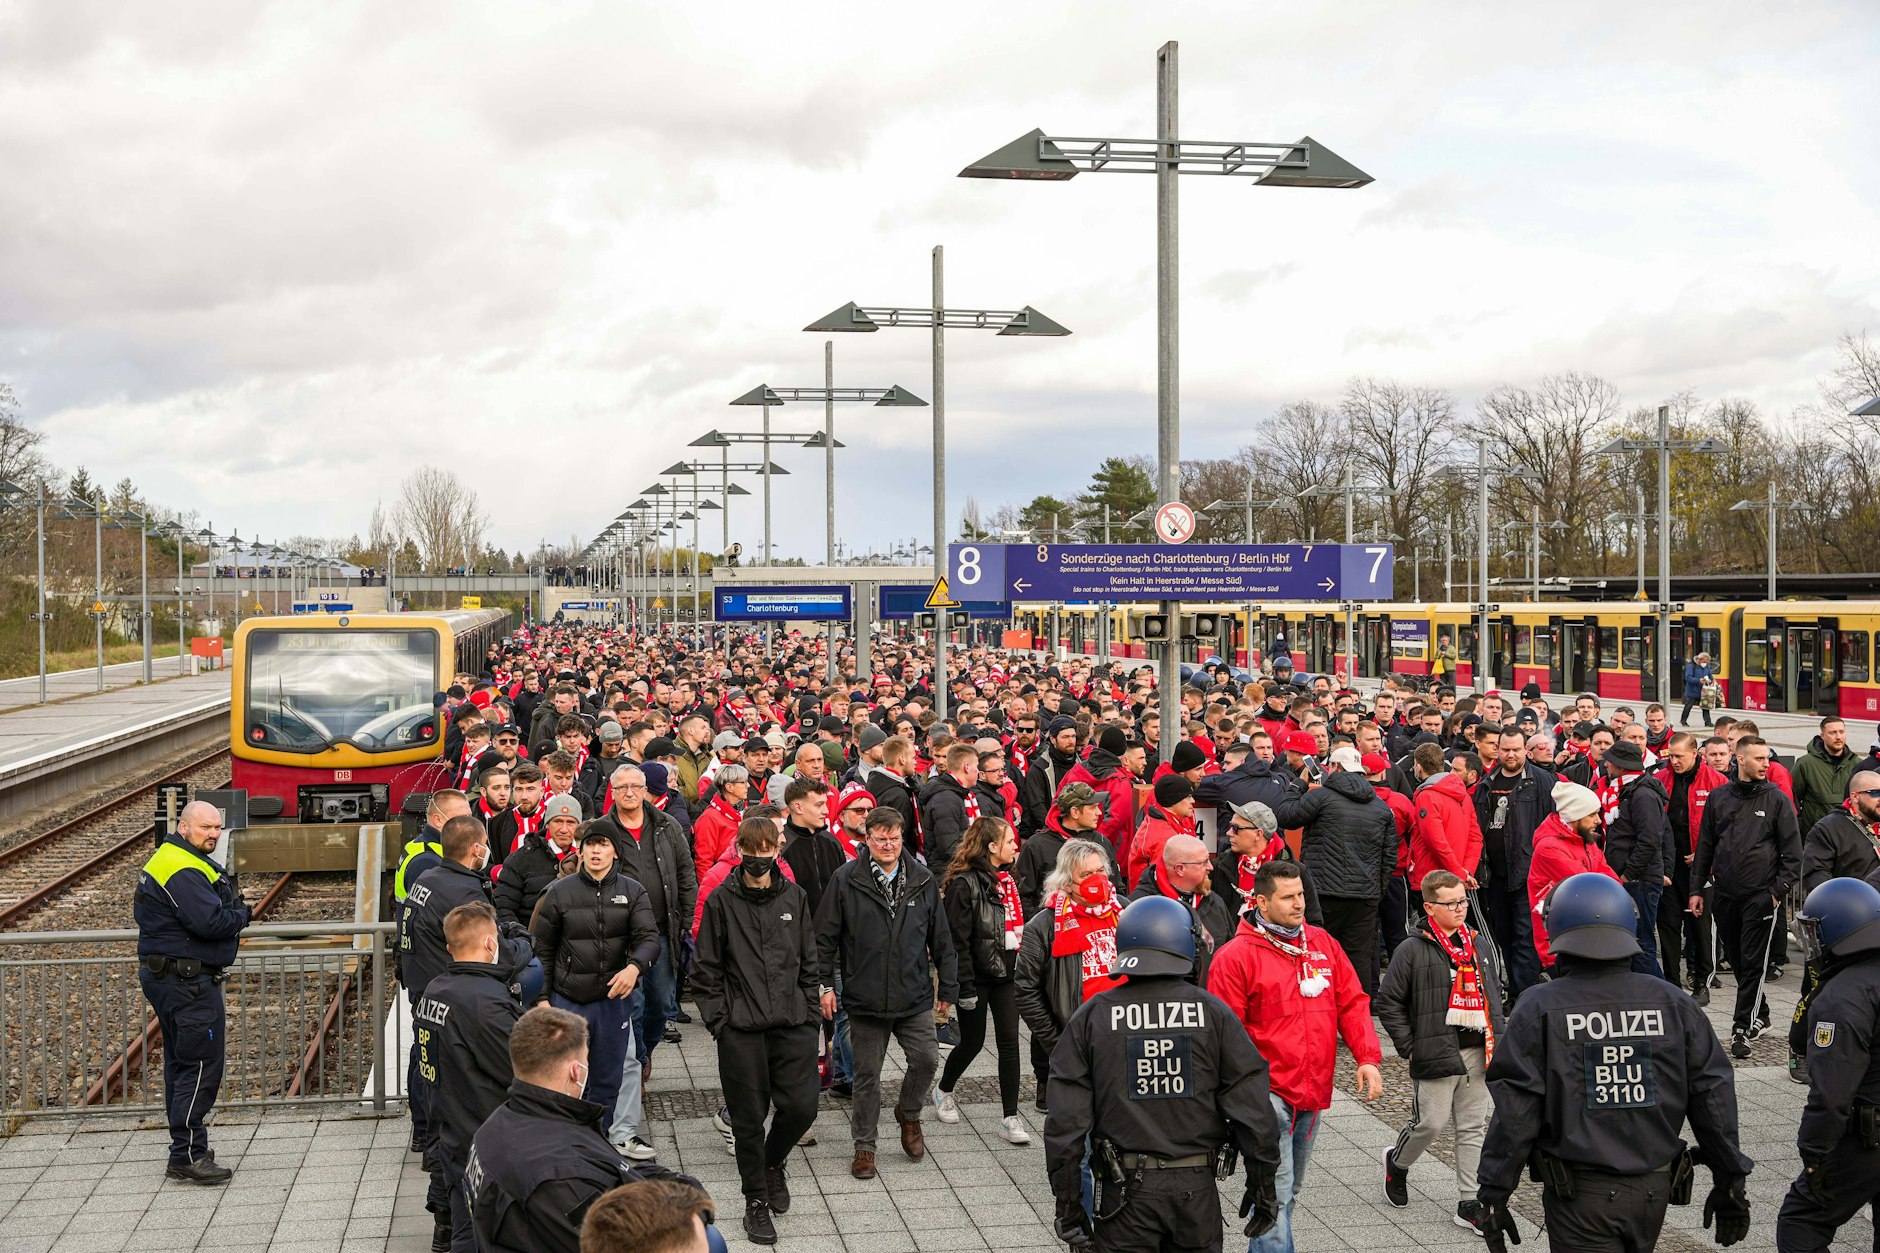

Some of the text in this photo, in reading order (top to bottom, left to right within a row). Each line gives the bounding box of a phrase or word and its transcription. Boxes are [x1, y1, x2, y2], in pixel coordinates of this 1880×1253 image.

[1037, 545, 1048, 562] 8
[1061, 553, 1290, 566] Sonderzüge nach Charlottenburg / Berlin Hbf
[1302, 545, 1313, 562] 7
[957, 546, 982, 585] 8
[1365, 547, 1387, 583] 7
[1110, 576, 1128, 585] (Kein
[1129, 576, 1145, 584] Halt
[1147, 576, 1153, 584] in
[1155, 576, 1194, 584] Heerstraße
[1201, 576, 1224, 584] Messe
[1225, 576, 1242, 585] Süd)
[747, 605, 798, 613] Charlottenburg
[287, 635, 304, 647] S3
[1867, 700, 1877, 709] DB
[398, 728, 411, 739] 42
[336, 771, 351, 780] DB
[403, 907, 412, 920] BP
[1119, 957, 1139, 968] 10
[1452, 993, 1479, 1008] Berlin
[416, 997, 450, 1027] OLIZEI
[1111, 1002, 1205, 1031] POLIZEI
[1566, 1009, 1665, 1040] POLIZEI
[418, 1027, 431, 1046] BP
[421, 1045, 428, 1062] B
[1143, 1039, 1175, 1057] BP
[1602, 1046, 1634, 1064] BP
[1137, 1057, 1182, 1077] BLU
[1595, 1064, 1643, 1084] BLU
[1136, 1076, 1185, 1095] 3110
[1595, 1084, 1646, 1104] 3110
